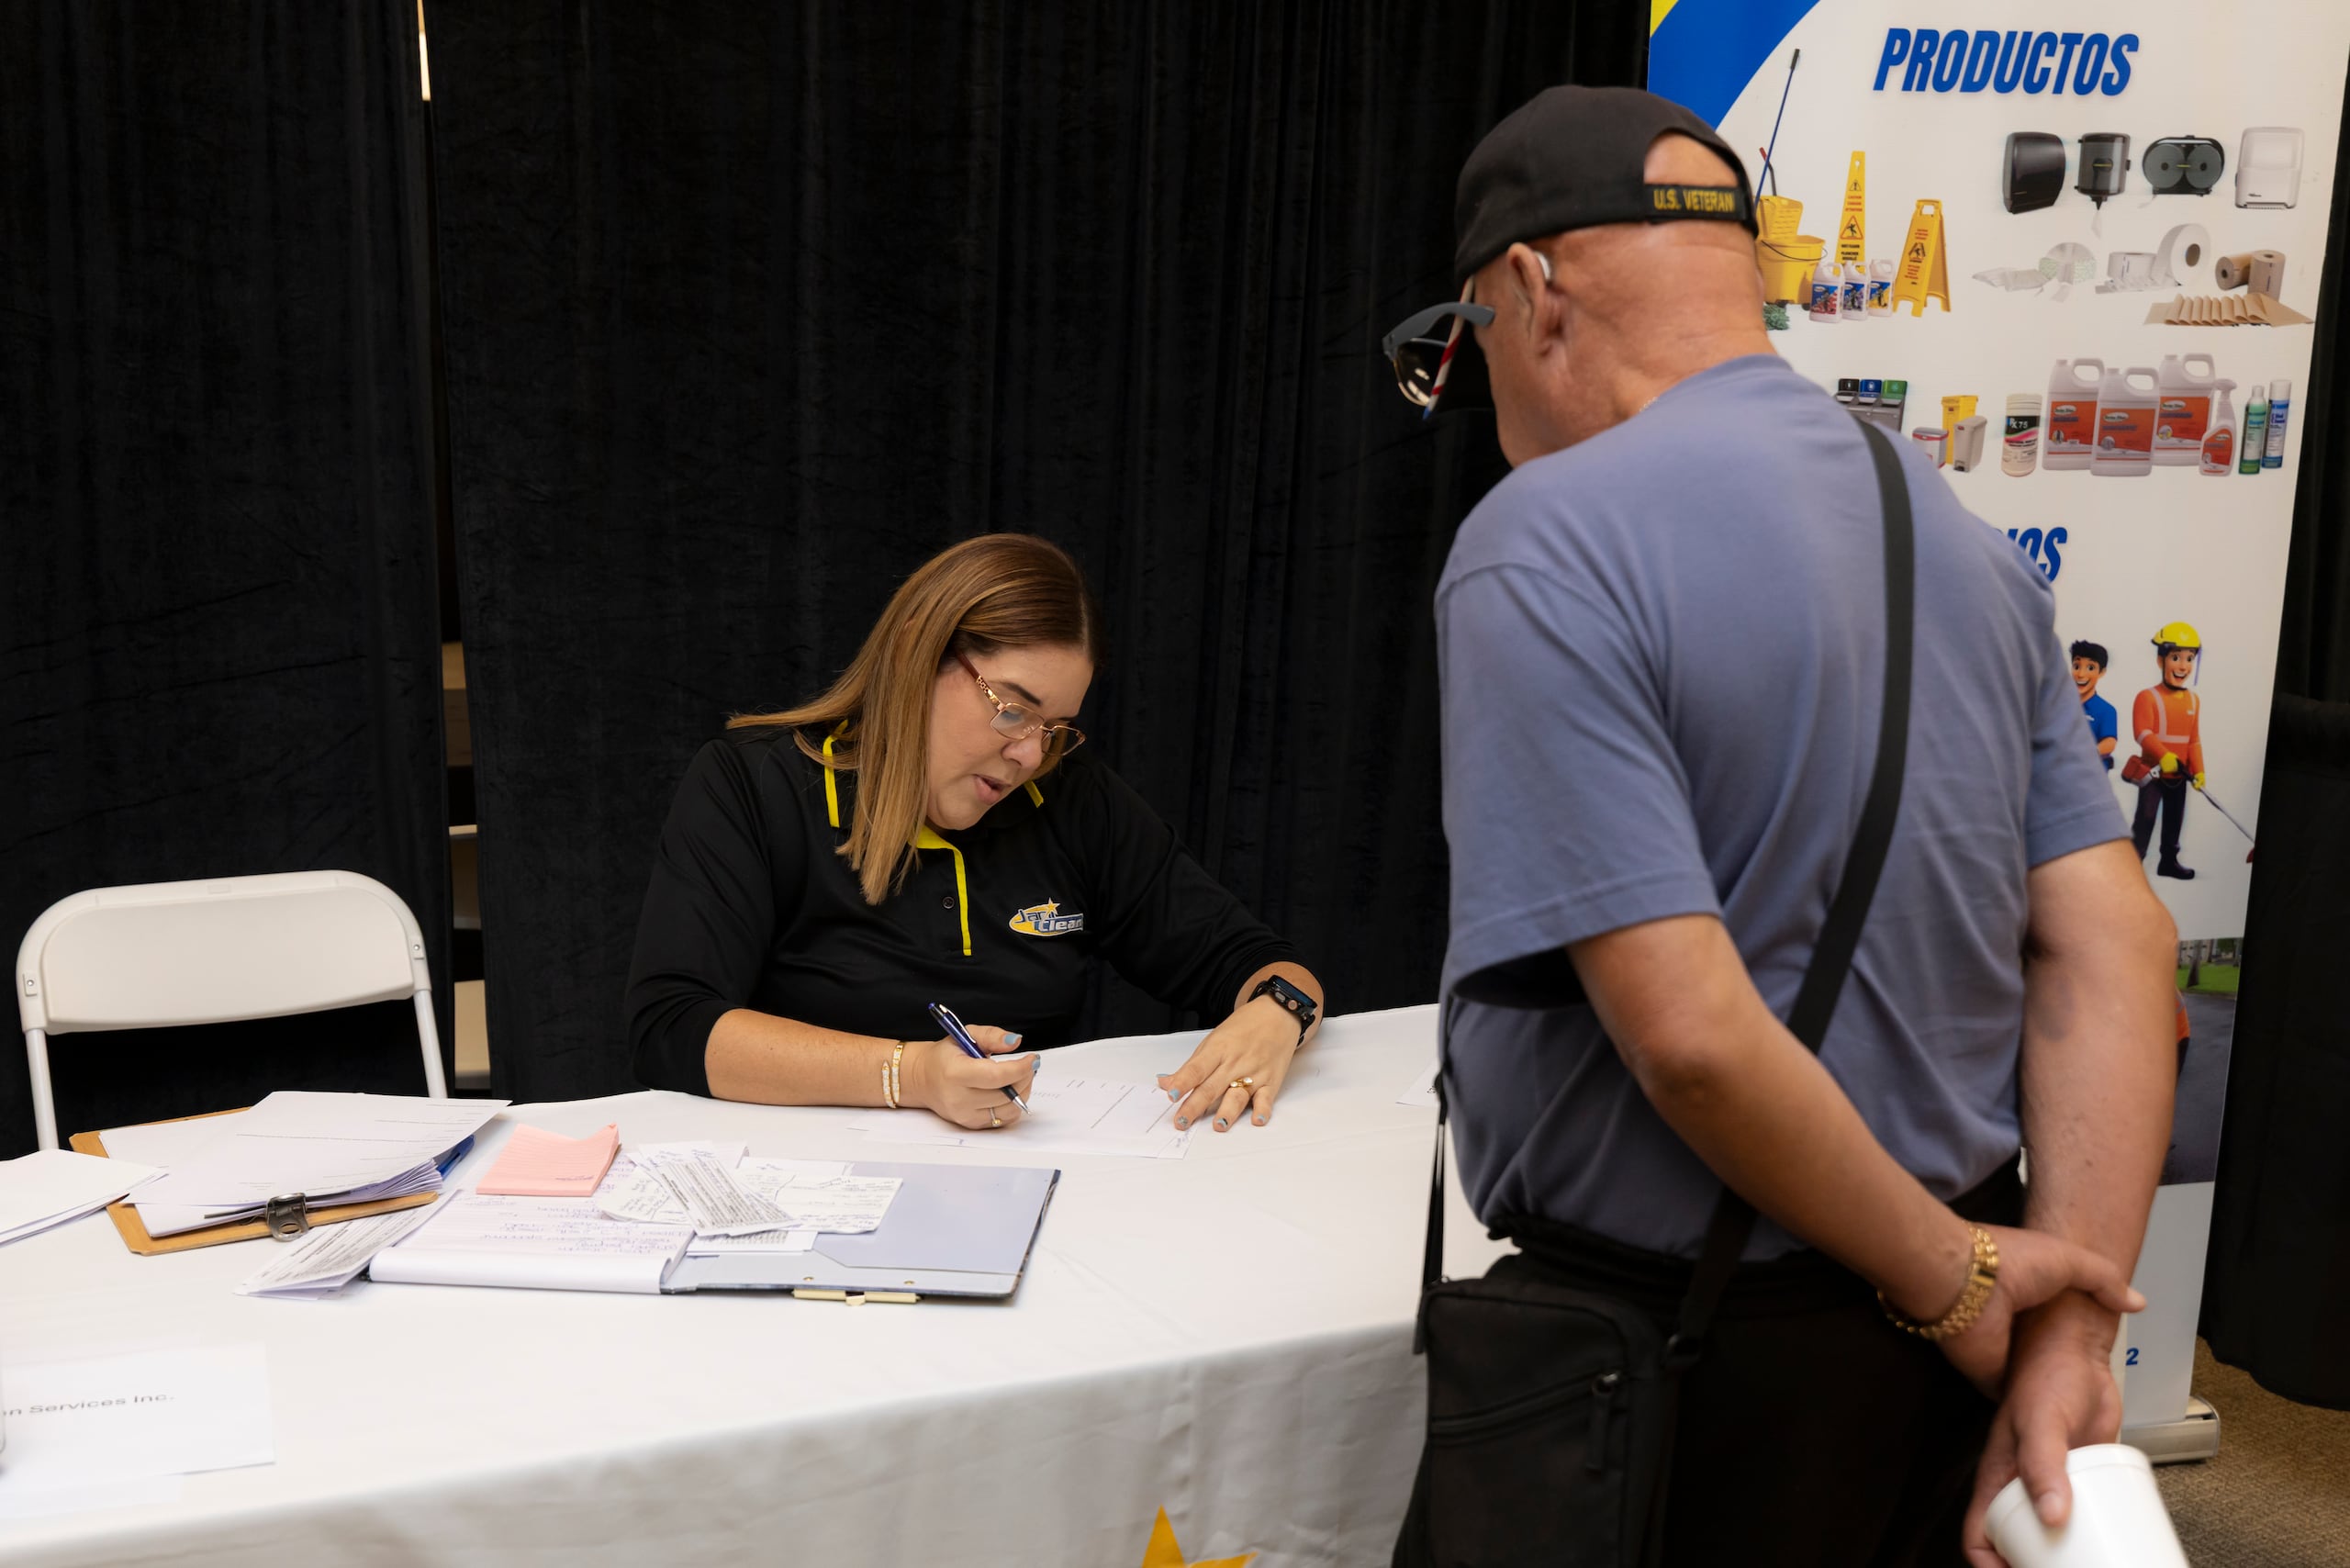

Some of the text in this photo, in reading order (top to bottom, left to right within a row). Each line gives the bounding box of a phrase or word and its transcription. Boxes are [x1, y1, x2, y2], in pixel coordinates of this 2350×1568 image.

[1873, 28, 2140, 95] PRODUCTOS
[1653, 188, 1734, 213] U.S. VETERAN
[1038, 918, 1083, 932] Clean
[29, 1398, 126, 1414] Services
[133, 1394, 174, 1404] Inc.
